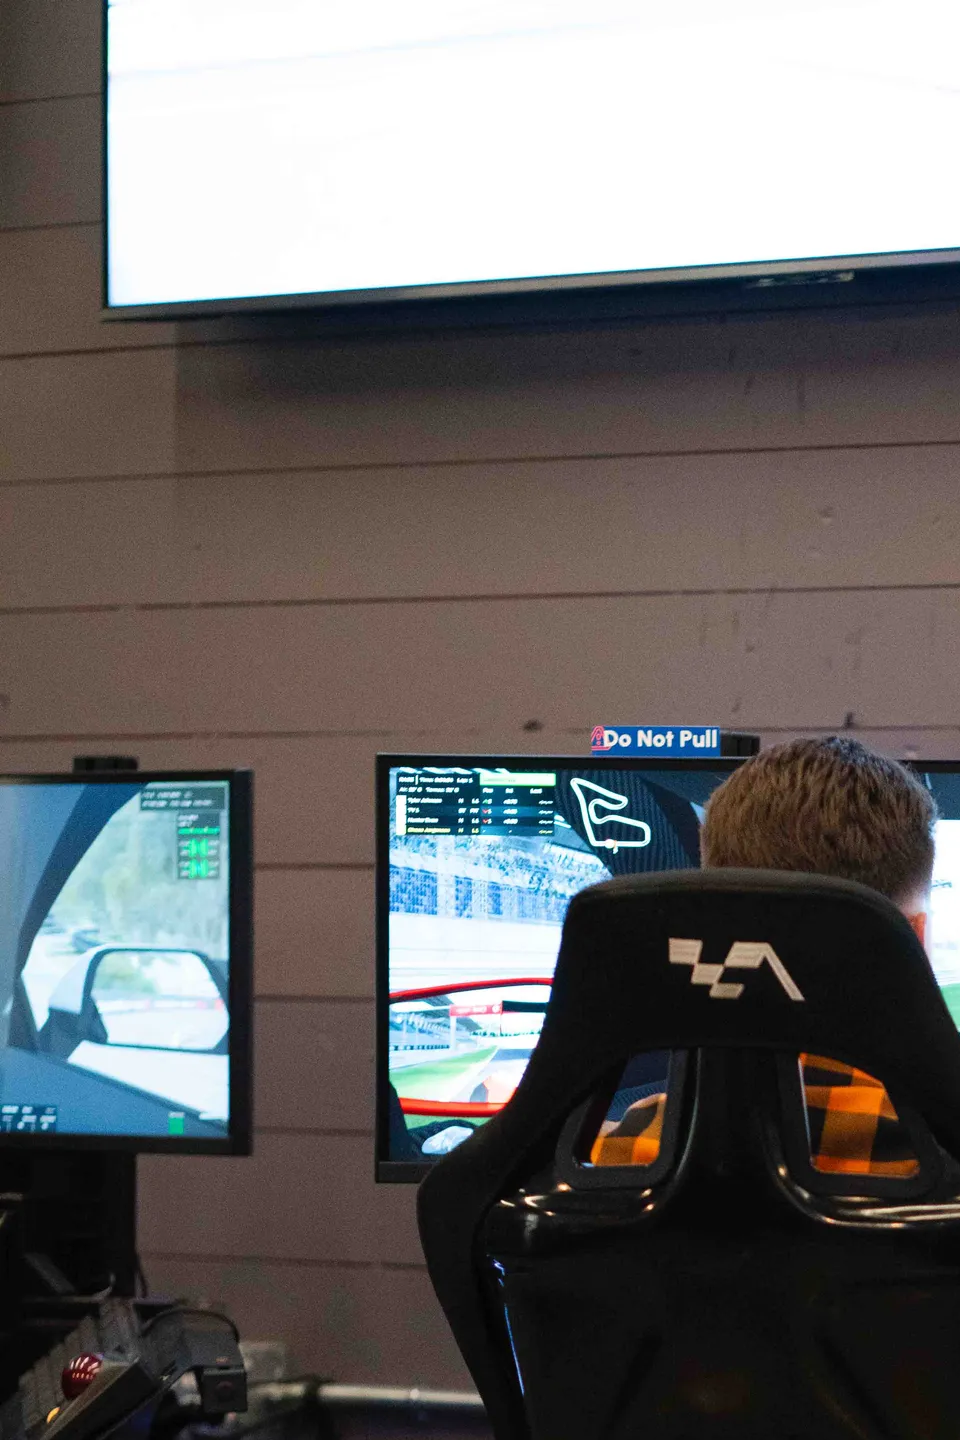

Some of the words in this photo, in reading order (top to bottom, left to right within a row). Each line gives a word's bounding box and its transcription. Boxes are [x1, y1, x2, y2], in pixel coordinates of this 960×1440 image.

[603, 729, 632, 748] Do
[637, 729, 674, 748] Not
[680, 729, 717, 748] Pull
